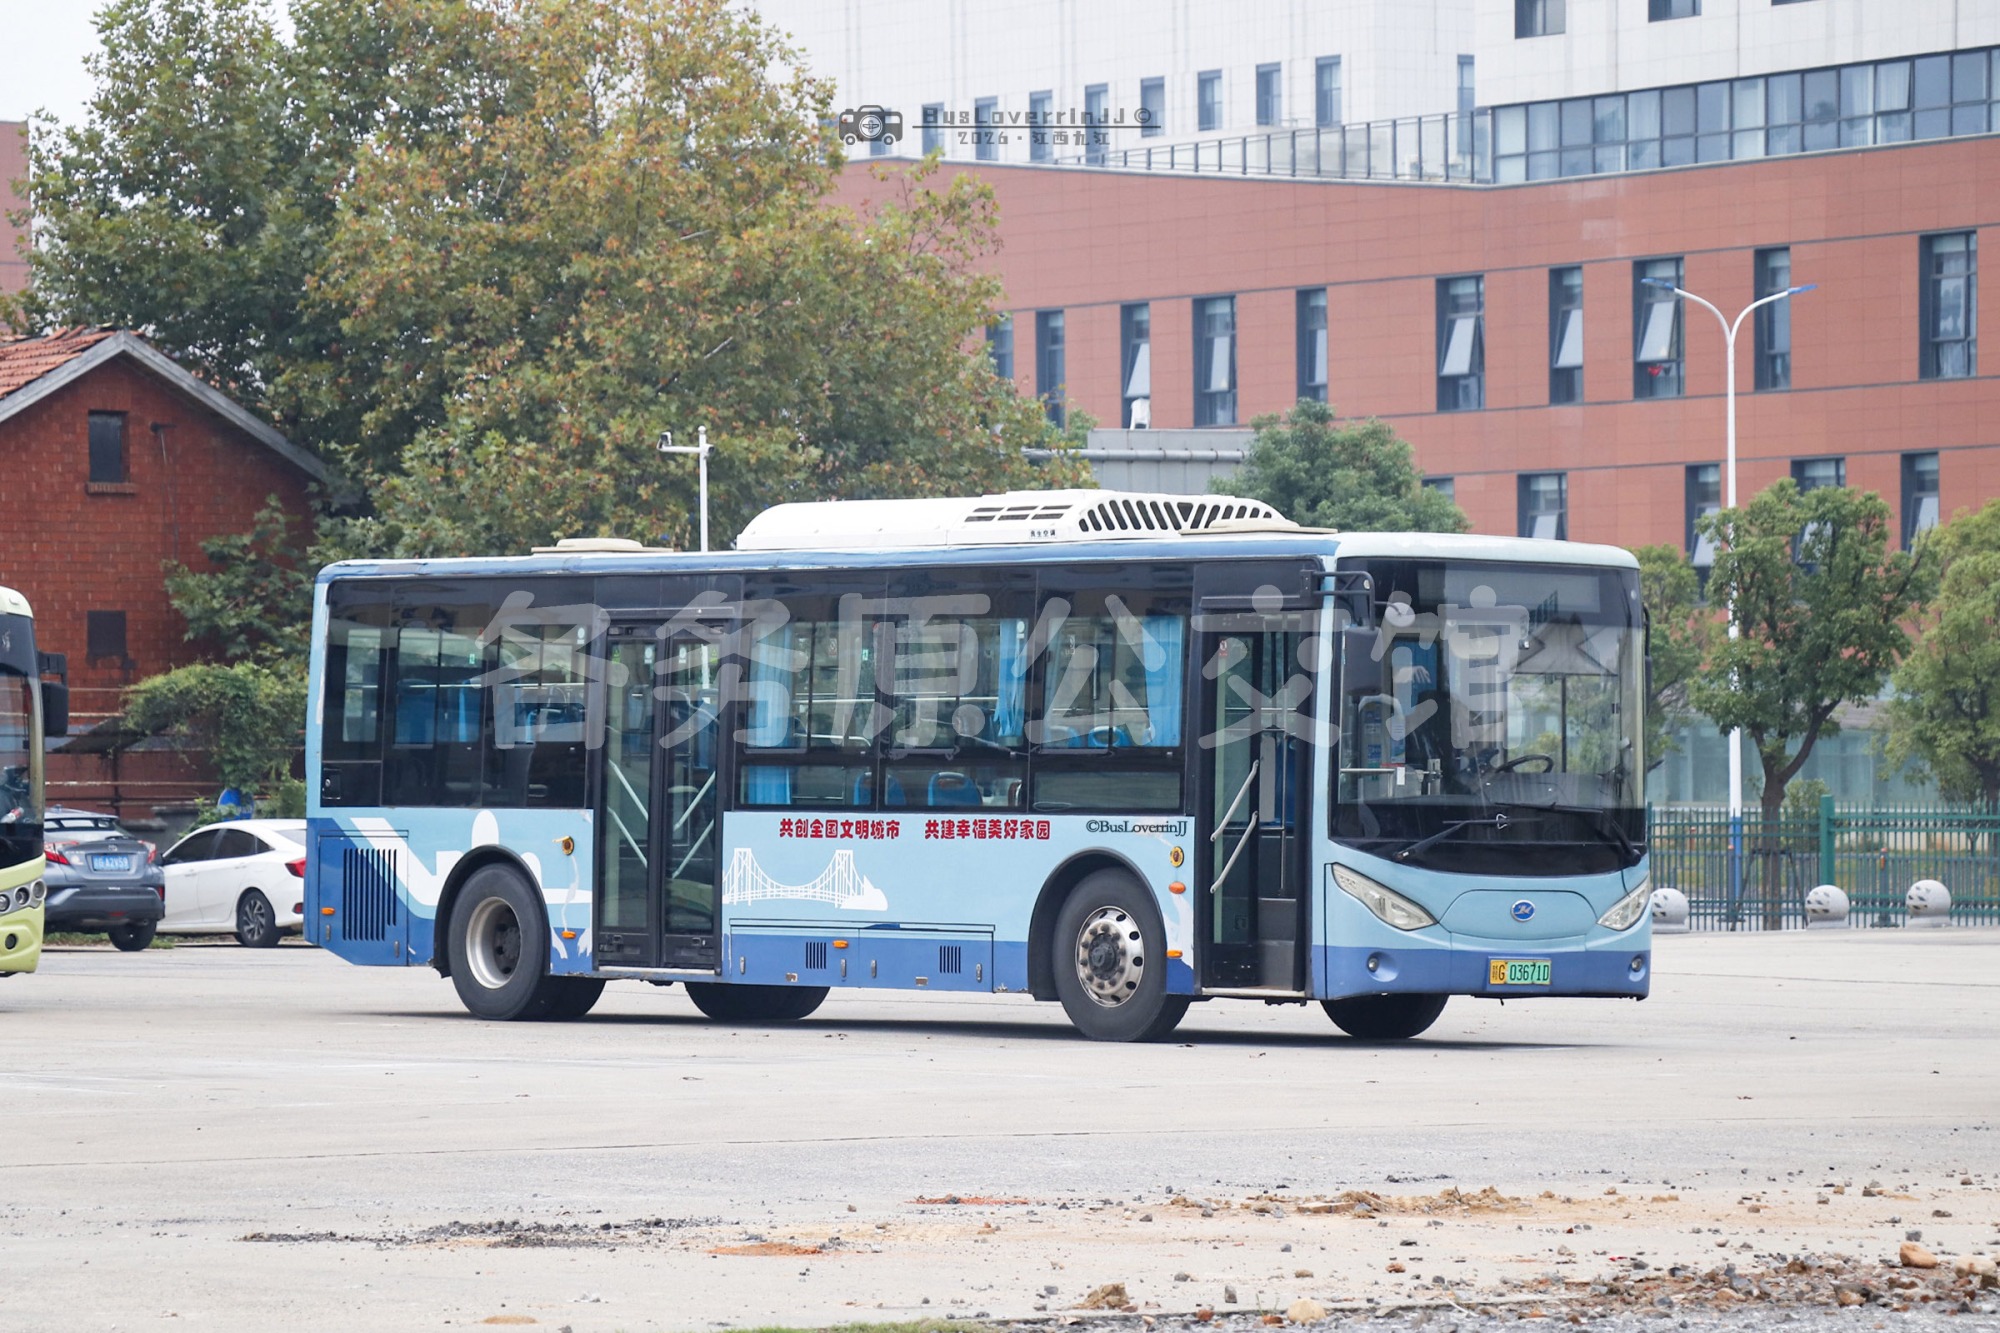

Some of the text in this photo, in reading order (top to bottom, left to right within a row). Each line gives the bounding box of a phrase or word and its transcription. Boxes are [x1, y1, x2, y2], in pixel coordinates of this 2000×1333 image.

[779, 818, 1050, 840] 共创全国文明城市 共建幸福美好家园
